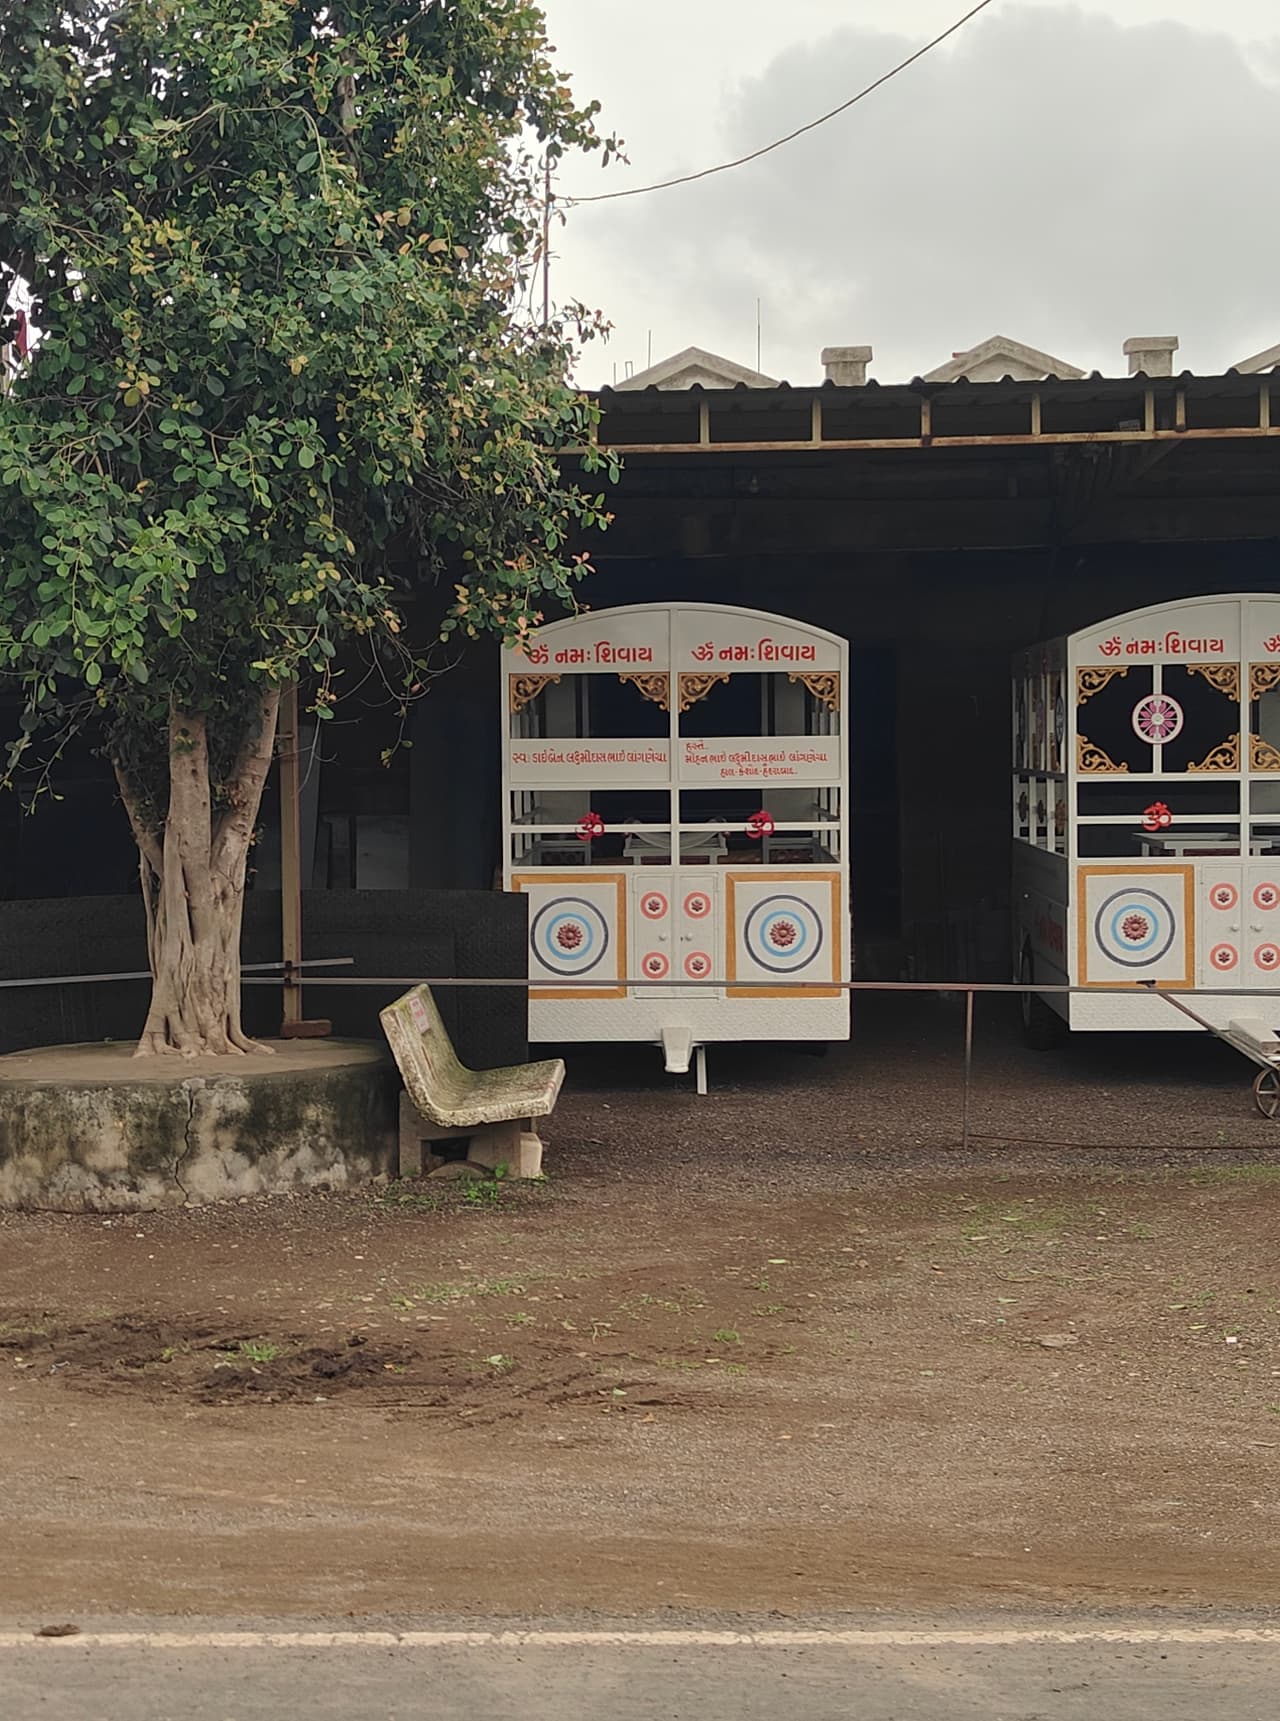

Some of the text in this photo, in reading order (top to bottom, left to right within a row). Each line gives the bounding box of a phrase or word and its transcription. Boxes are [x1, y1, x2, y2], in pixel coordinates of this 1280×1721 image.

[594, 641, 653, 663] શિવાય
[758, 638, 816, 661] શિવાય
[1164, 631, 1224, 654] શિવાય
